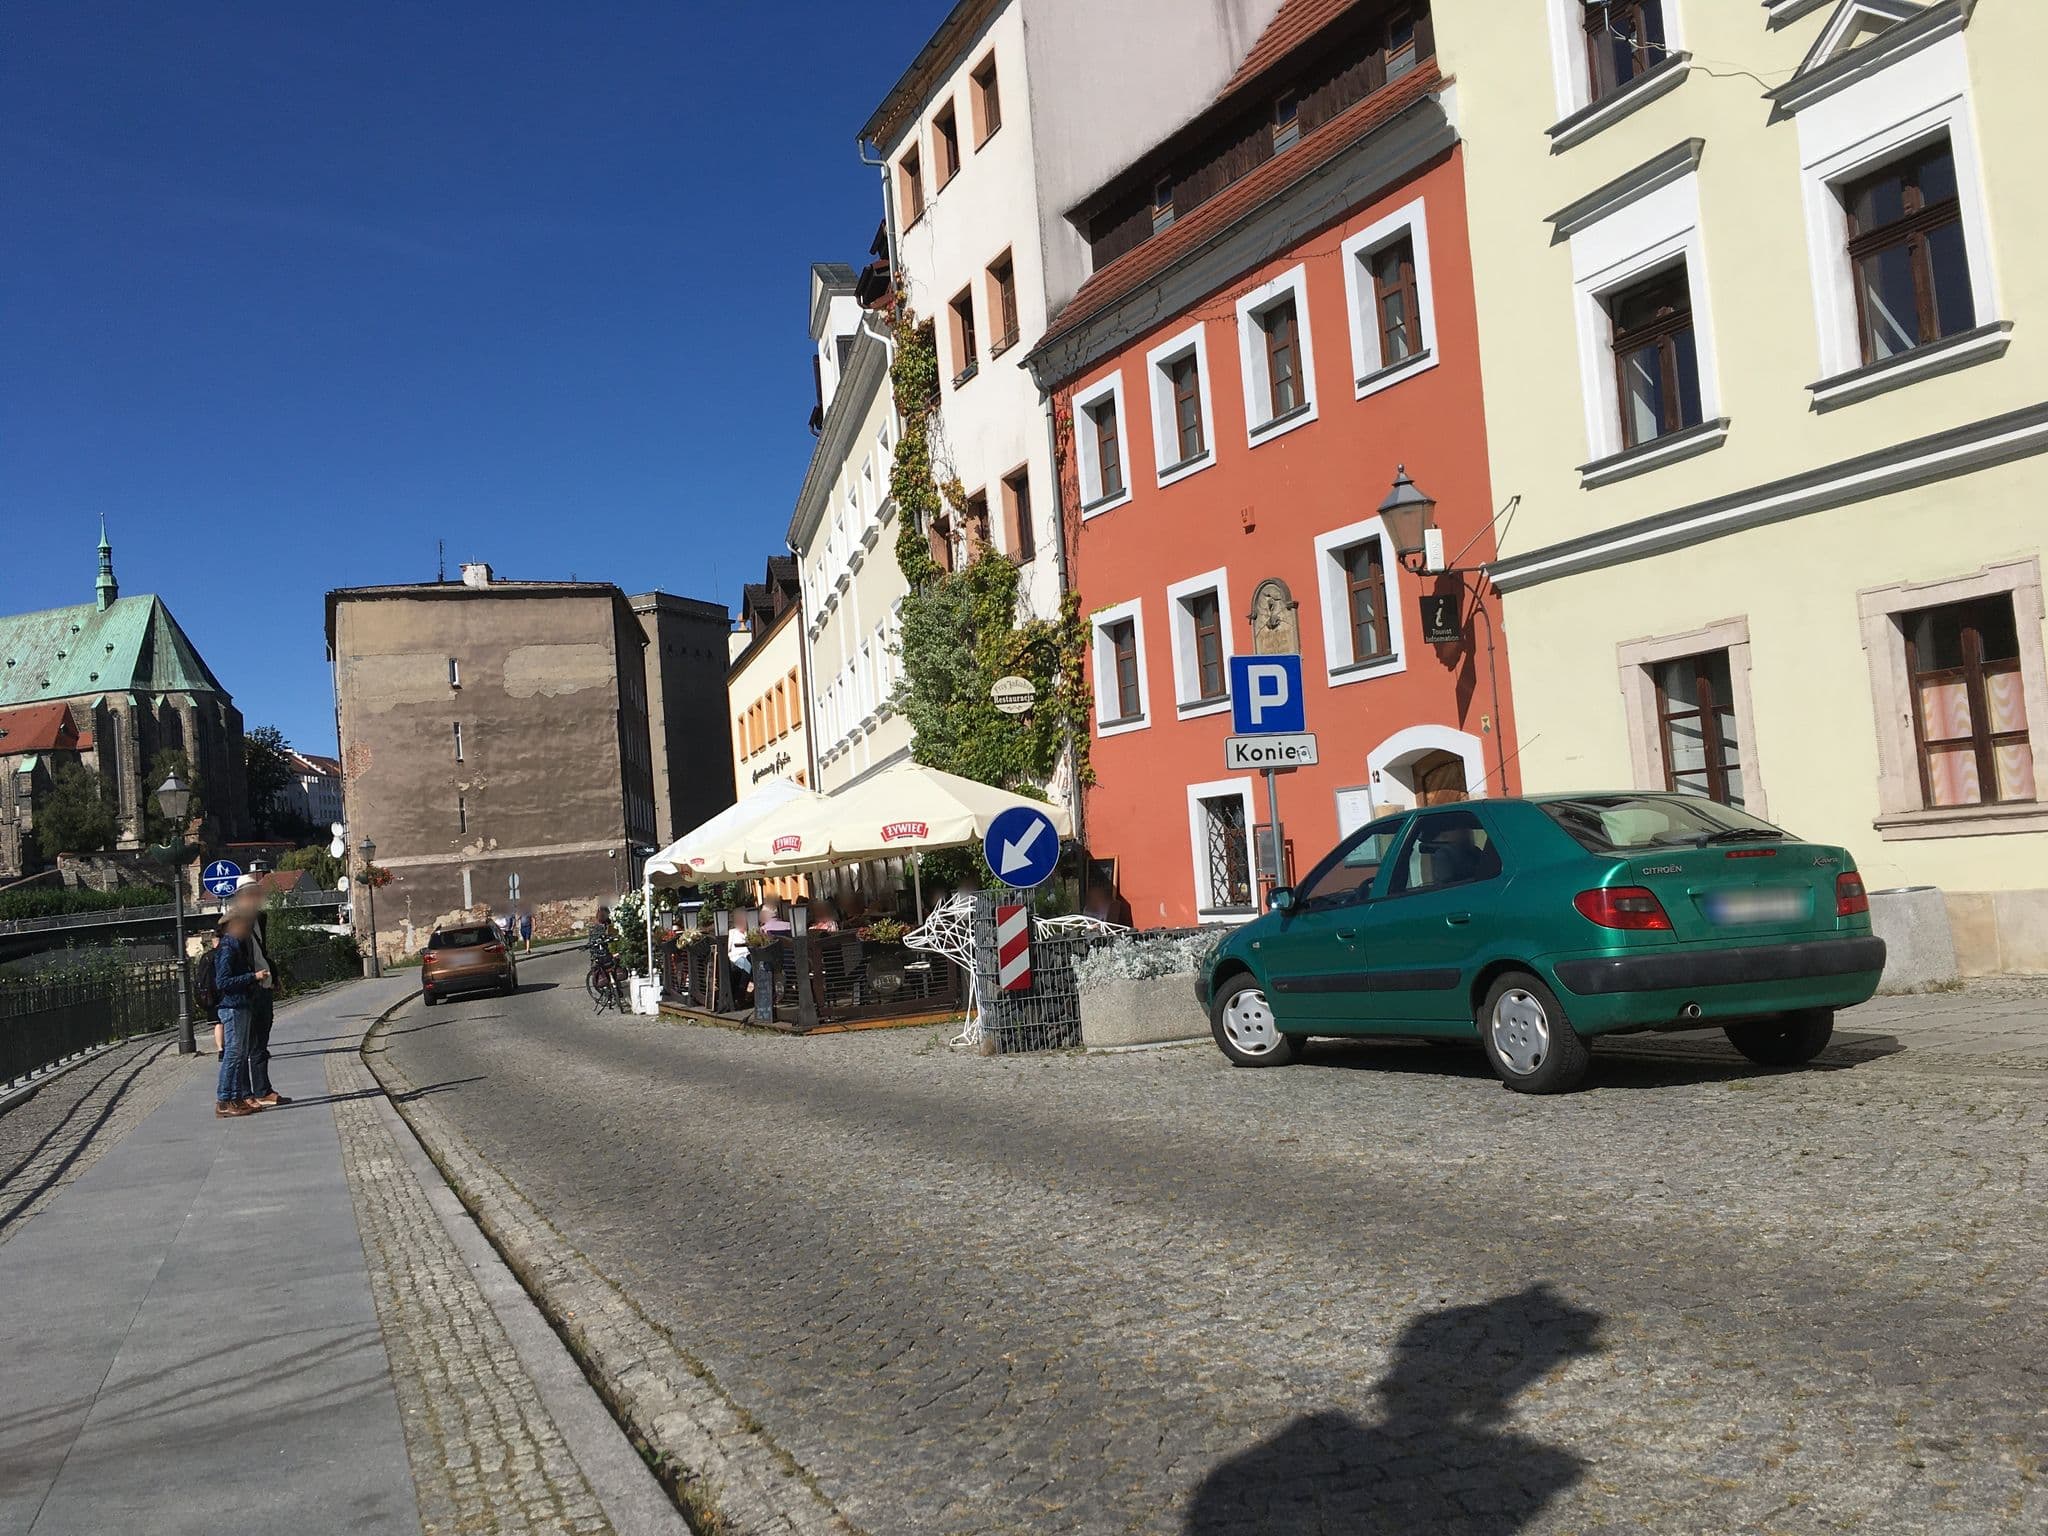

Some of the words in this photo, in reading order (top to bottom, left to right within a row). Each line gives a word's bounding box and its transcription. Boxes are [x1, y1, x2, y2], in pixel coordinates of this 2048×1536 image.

[993, 694, 1035, 704] Restauracja
[1247, 664, 1289, 725] P
[1642, 864, 1682, 876] CITROËN
